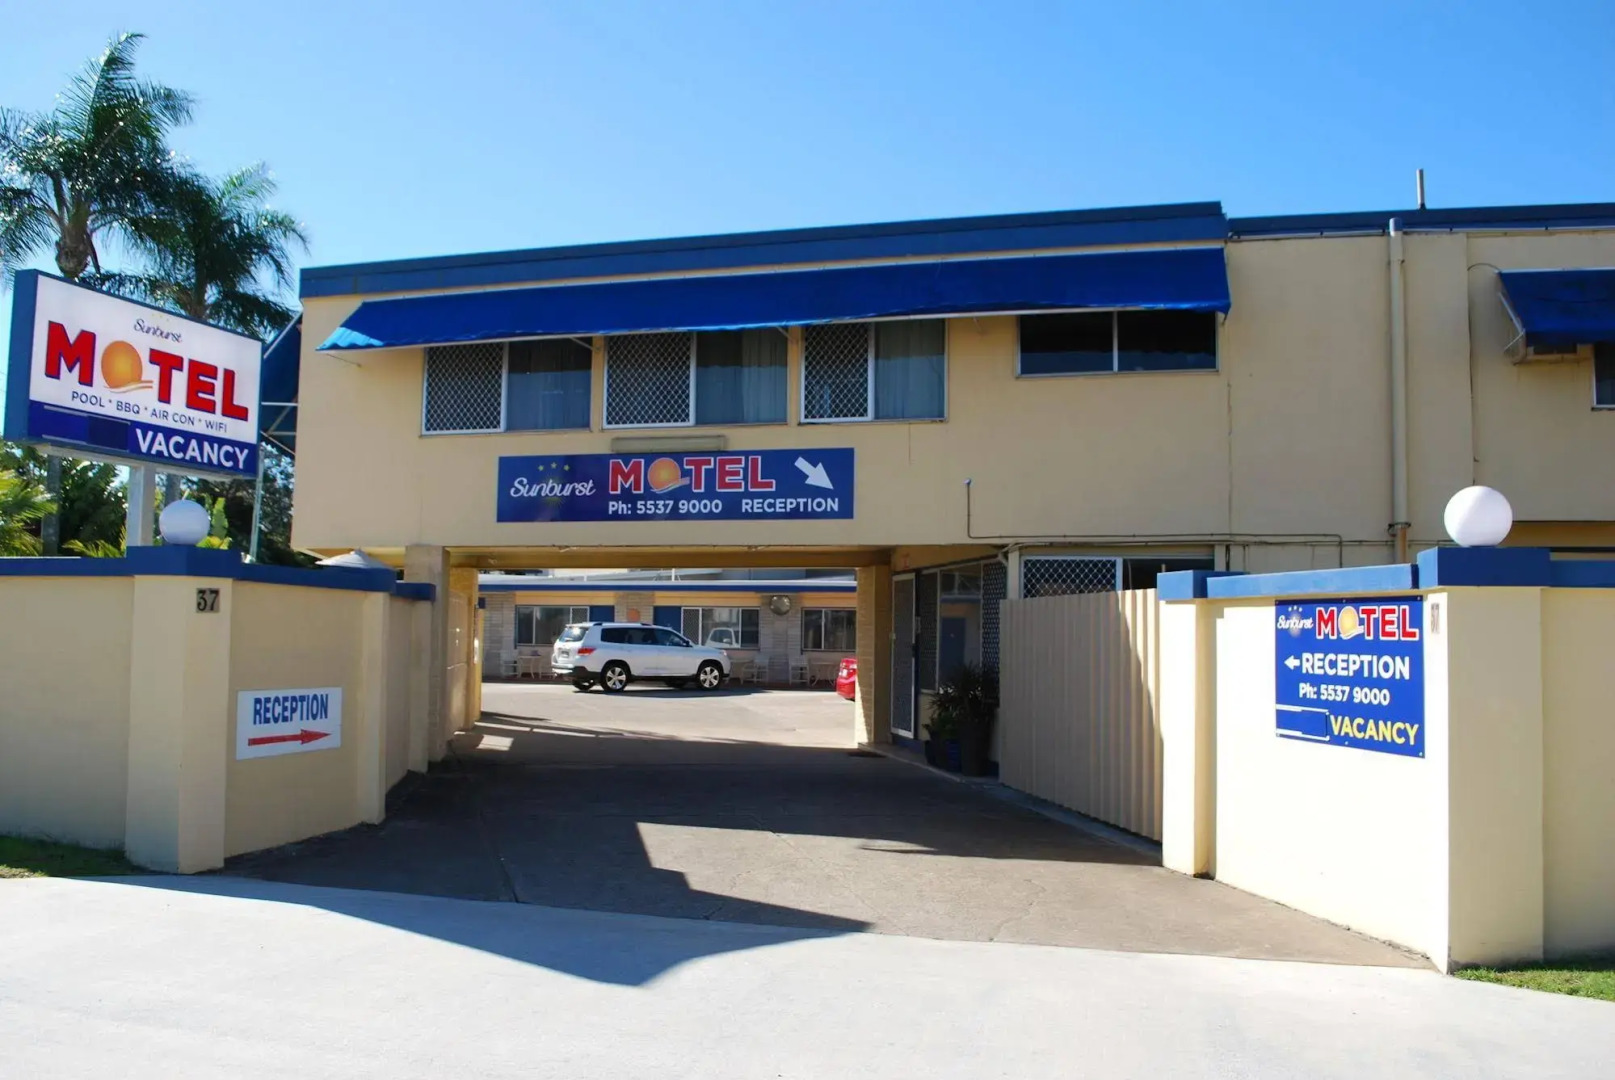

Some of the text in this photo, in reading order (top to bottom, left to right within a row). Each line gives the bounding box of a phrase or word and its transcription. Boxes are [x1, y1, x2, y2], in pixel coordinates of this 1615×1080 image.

[134, 318, 182, 344] Sunburst
[71, 390, 228, 433] POOL BBQ AIR CON WIFI
[135, 428, 249, 469] VACANCY
[510, 477, 596, 497] Sunburst
[608, 498, 839, 515] Ph: 5537 9000 RECEPTION
[197, 590, 219, 612] 37
[1277, 615, 1314, 630] Sunburst
[1302, 652, 1410, 680] RECEPTION
[1299, 683, 1390, 706] Ph: 5537 9000
[253, 694, 329, 725] RECEPTION
[1330, 714, 1419, 745] VACANCY
